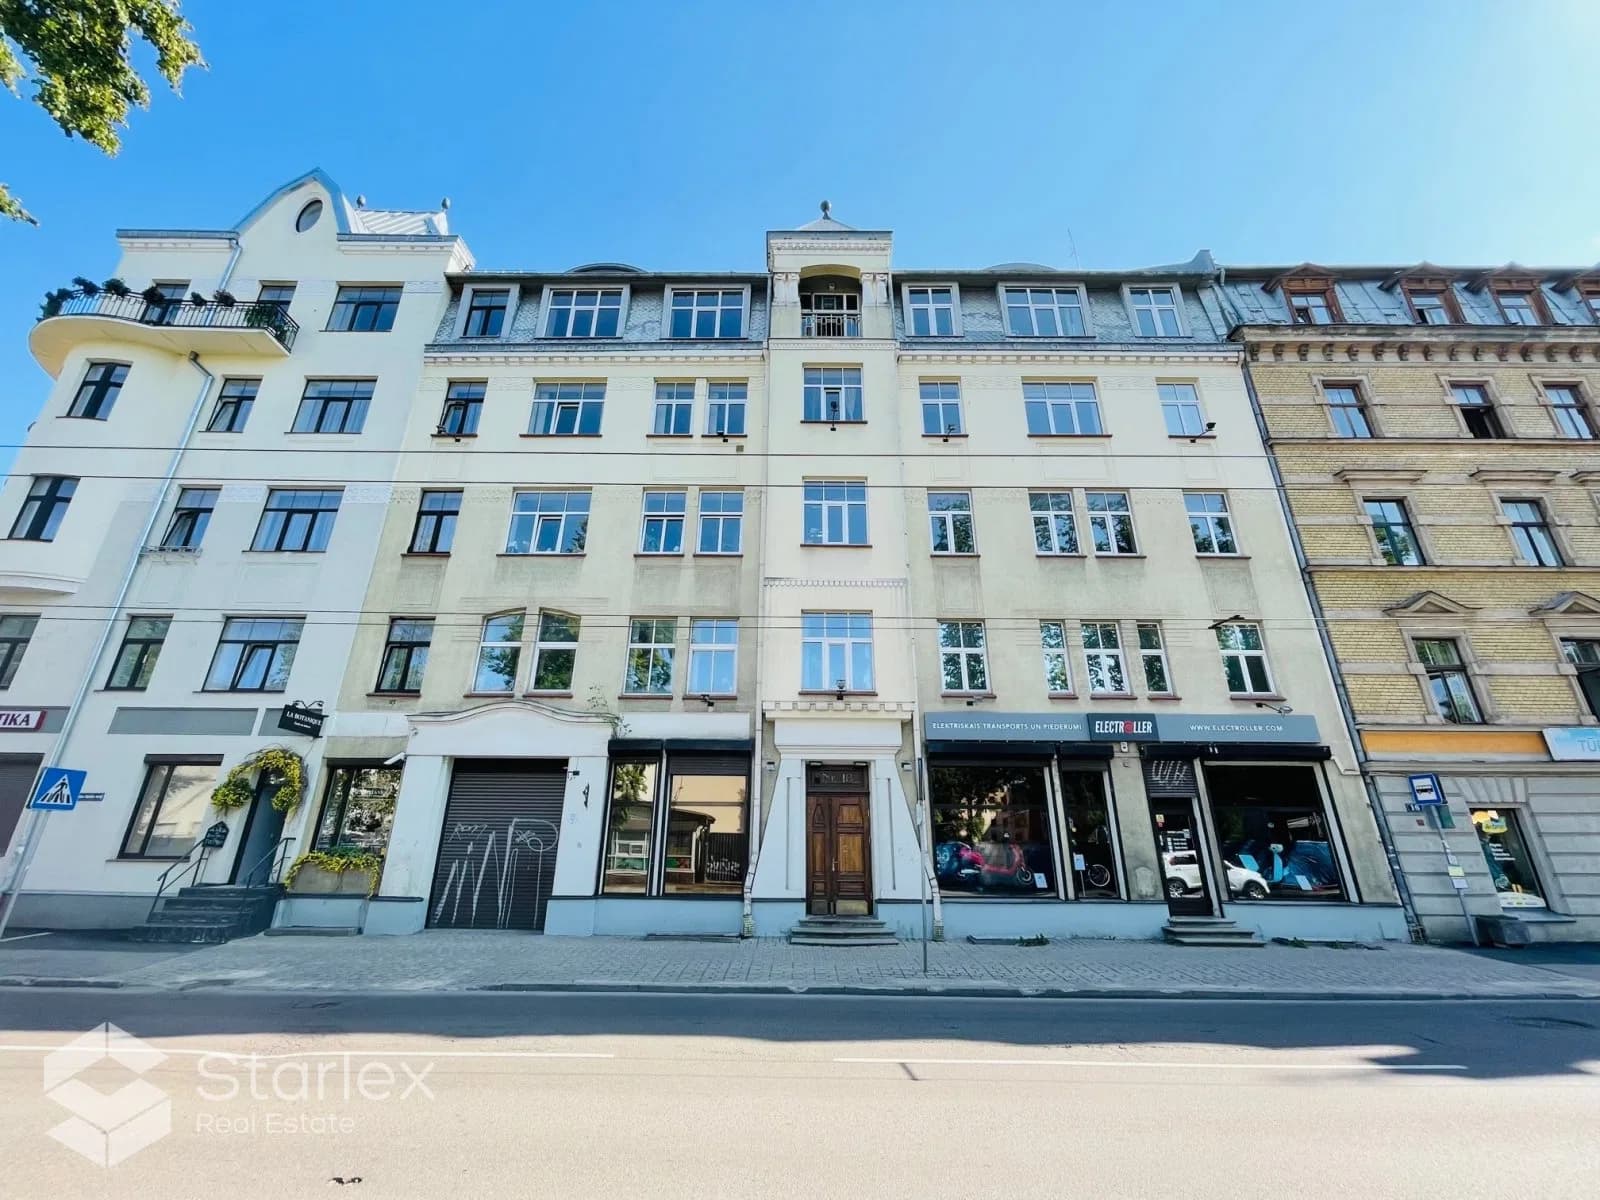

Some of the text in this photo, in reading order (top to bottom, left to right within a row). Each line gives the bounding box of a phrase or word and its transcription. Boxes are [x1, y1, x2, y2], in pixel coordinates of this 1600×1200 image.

[932, 722, 981, 730] ELEKTRISKAIS
[1043, 723, 1082, 731] PIEDERUMI
[1095, 720, 1152, 734] ELECTROLLER
[1189, 723, 1284, 733] WWW.ELECTROLLER.COM
[1576, 737, 1600, 752] TŪ
